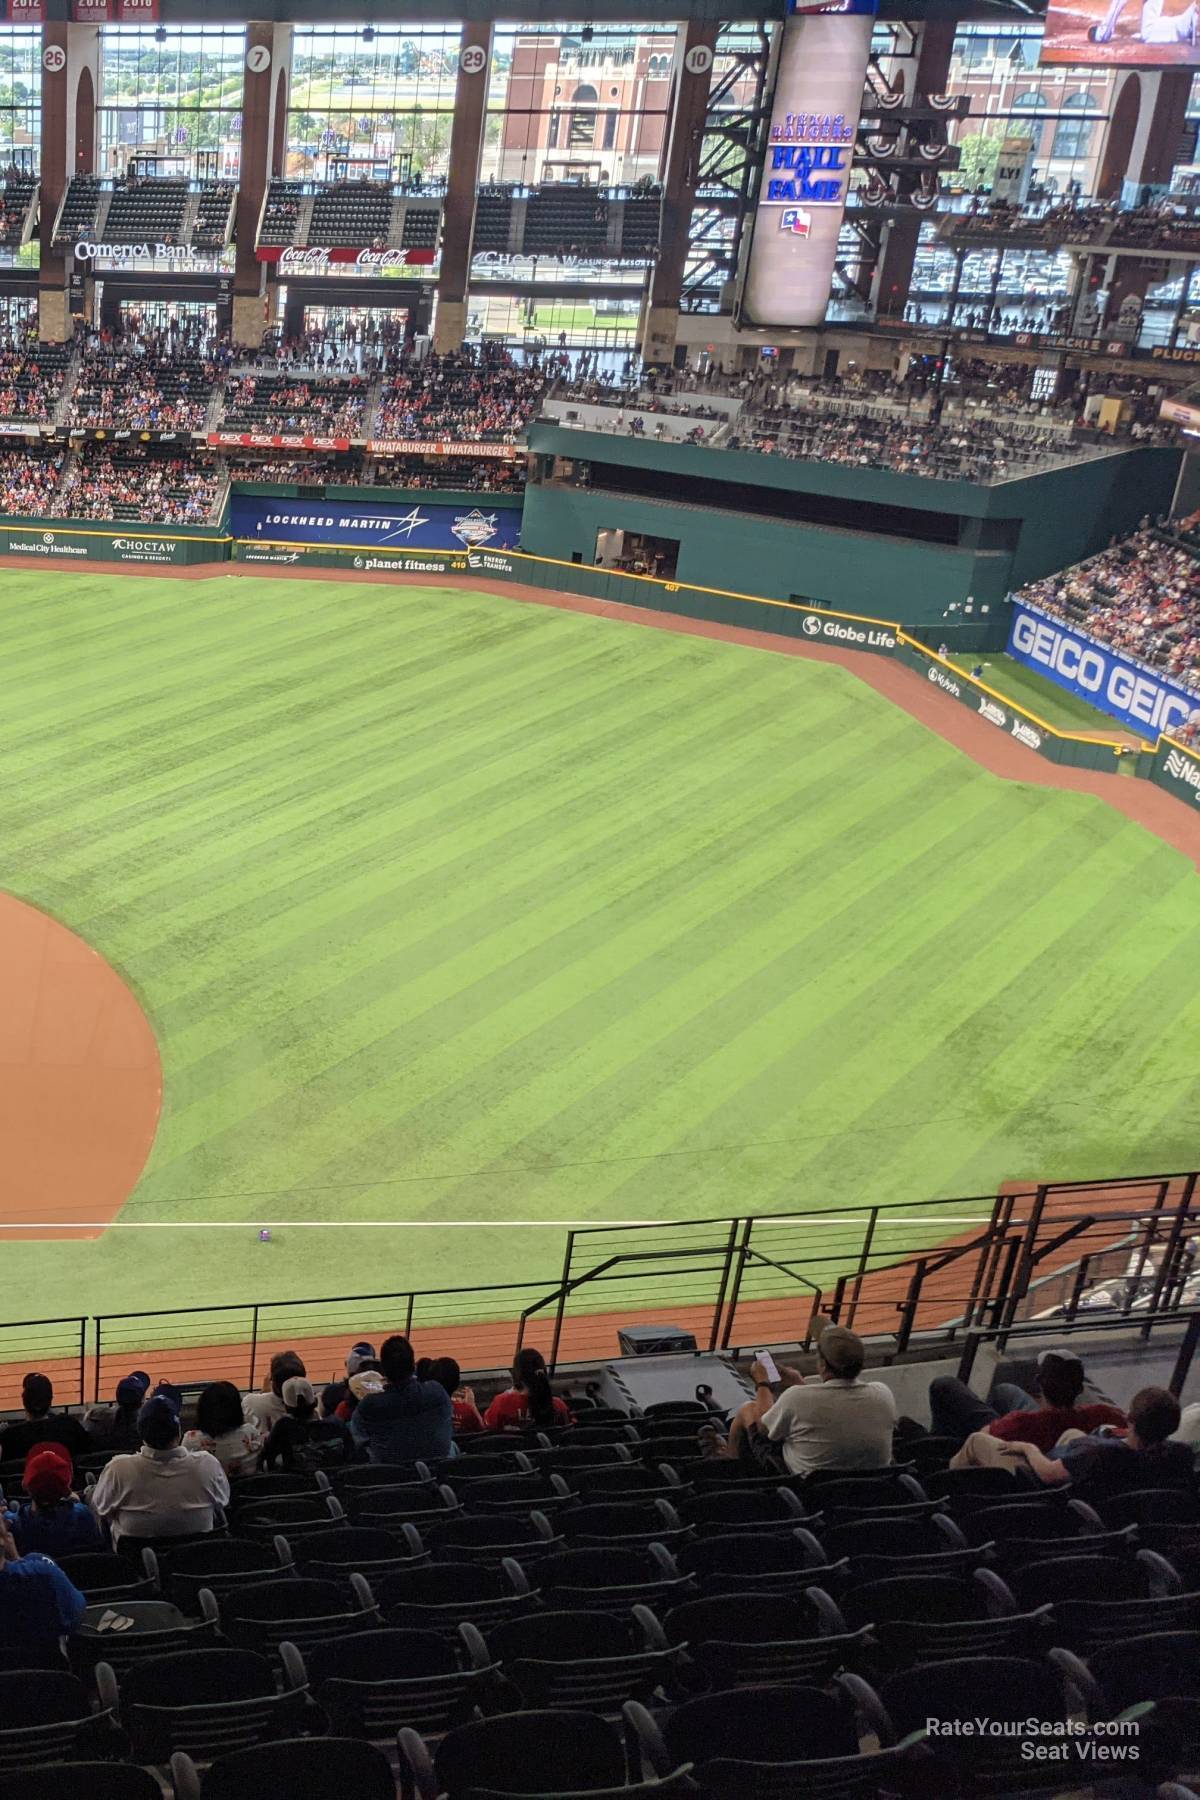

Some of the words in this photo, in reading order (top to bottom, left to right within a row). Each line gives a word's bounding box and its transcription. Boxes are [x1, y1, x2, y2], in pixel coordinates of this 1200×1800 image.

[44, 50, 64, 66] 26
[253, 50, 264, 67] 7
[463, 50, 485, 67] 29
[689, 50, 708, 68] 10
[785, 112, 845, 125] TEXAS
[772, 125, 853, 138] RANGERS
[772, 146, 846, 170] HALL
[767, 179, 843, 201] FAME
[155, 244, 198, 260] Bank
[220, 434, 242, 442] DEX
[250, 435, 272, 443] DEX
[281, 436, 304, 444] DEX
[312, 437, 335, 446] DEX
[371, 440, 437, 454] WHATABURGER
[442, 444, 510, 456] WHATABURGER
[266, 514, 334, 527] LOCKHEED
[339, 517, 392, 530] MARTIN
[9, 542, 35, 552] Medical
[35, 543, 50, 555] City
[50, 544, 88, 555] Healthcare
[117, 538, 176, 552] CHOCTAW
[365, 557, 401, 572] planet
[402, 560, 445, 572] fitness
[484, 556, 507, 564] ENERGY
[484, 562, 512, 572] TRANSFER
[823, 621, 867, 643] Globe
[868, 629, 896, 648] Life
[1012, 613, 1105, 693] GEICO
